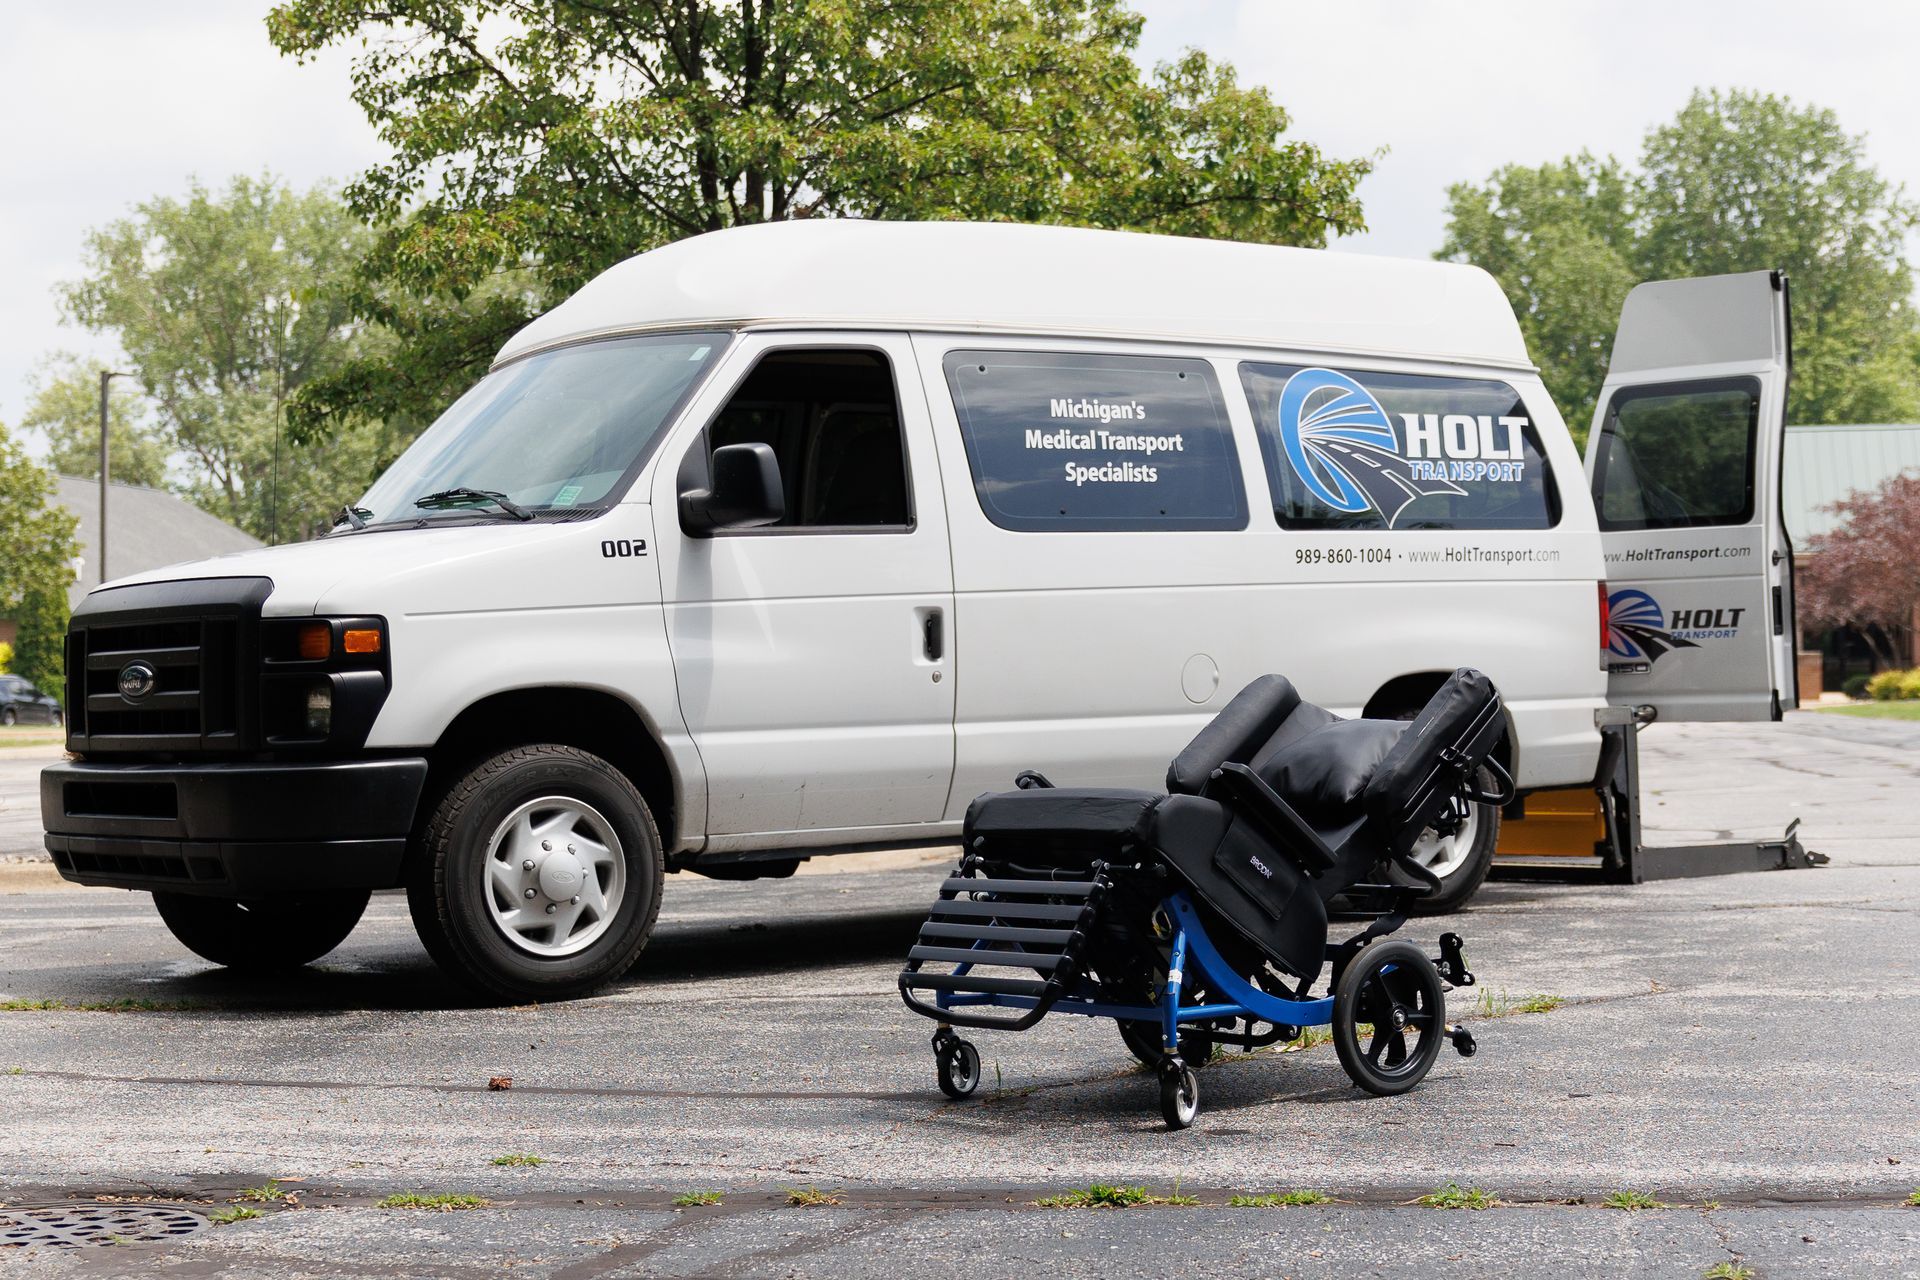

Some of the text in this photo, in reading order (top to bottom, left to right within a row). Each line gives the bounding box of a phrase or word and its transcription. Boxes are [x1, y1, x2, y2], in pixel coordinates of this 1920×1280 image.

[1050, 398, 1146, 424] Michigan's
[1025, 429, 1184, 455] Medical Transport
[1398, 413, 1529, 460] HOLT
[1065, 461, 1158, 487] Specialists
[1408, 460, 1525, 482] TRANSPORT
[601, 539, 648, 558] 002
[1295, 546, 1561, 566] 989-860-1004 www.HoltTransport.com
[1670, 608, 1746, 630] HOLT
[1670, 629, 1738, 641] TRANSPORT
